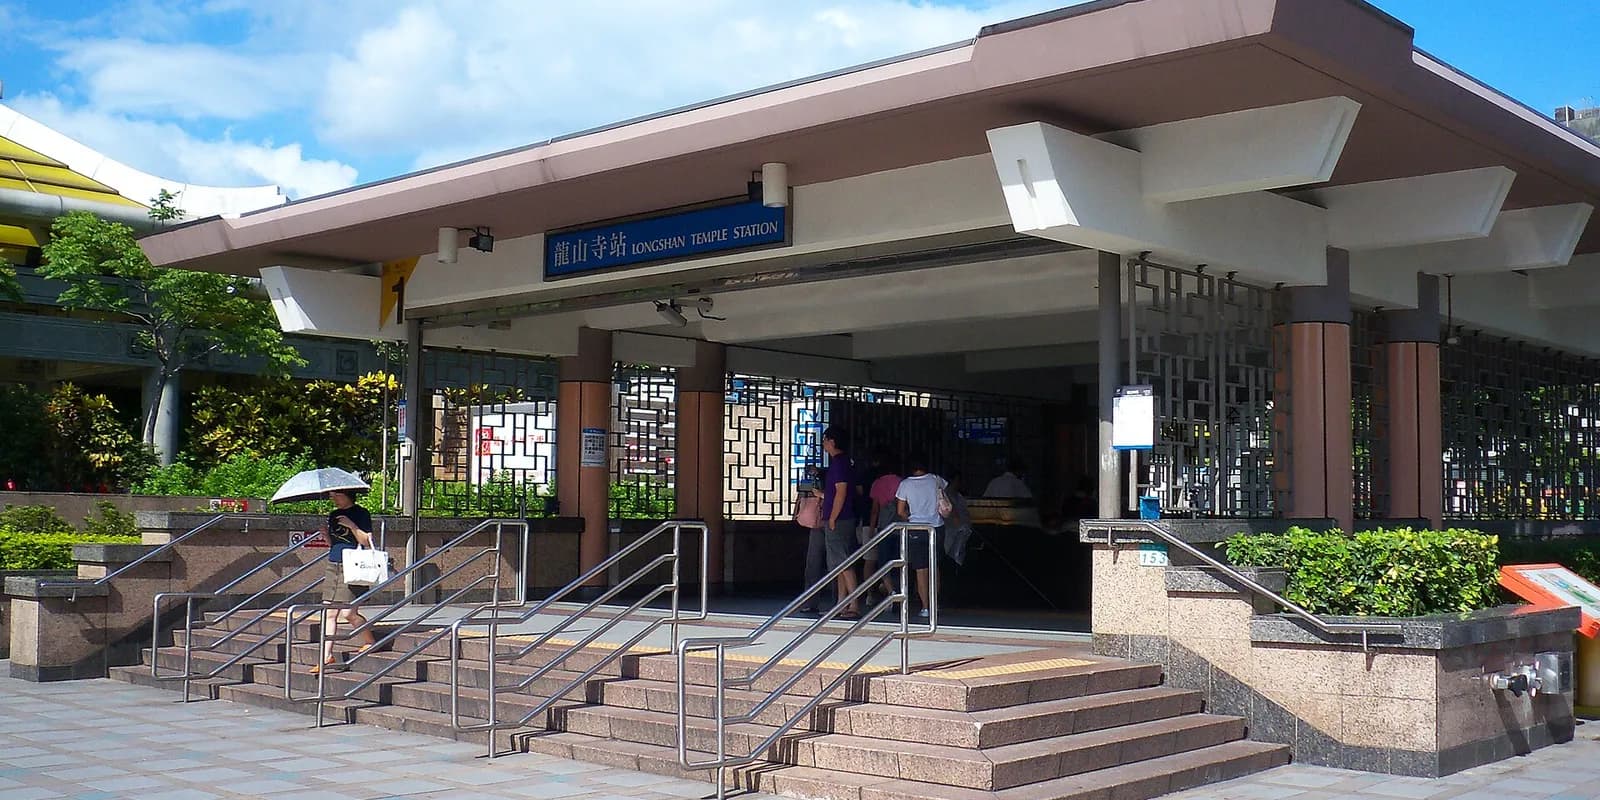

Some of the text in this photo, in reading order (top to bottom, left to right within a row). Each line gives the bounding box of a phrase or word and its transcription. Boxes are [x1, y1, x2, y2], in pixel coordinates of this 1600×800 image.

[554, 232, 626, 267] 龍山寺站
[631, 220, 778, 255] LONGSHAN TEMPLE STATION
[392, 276, 404, 325] 1
[1142, 552, 1167, 564] 153
